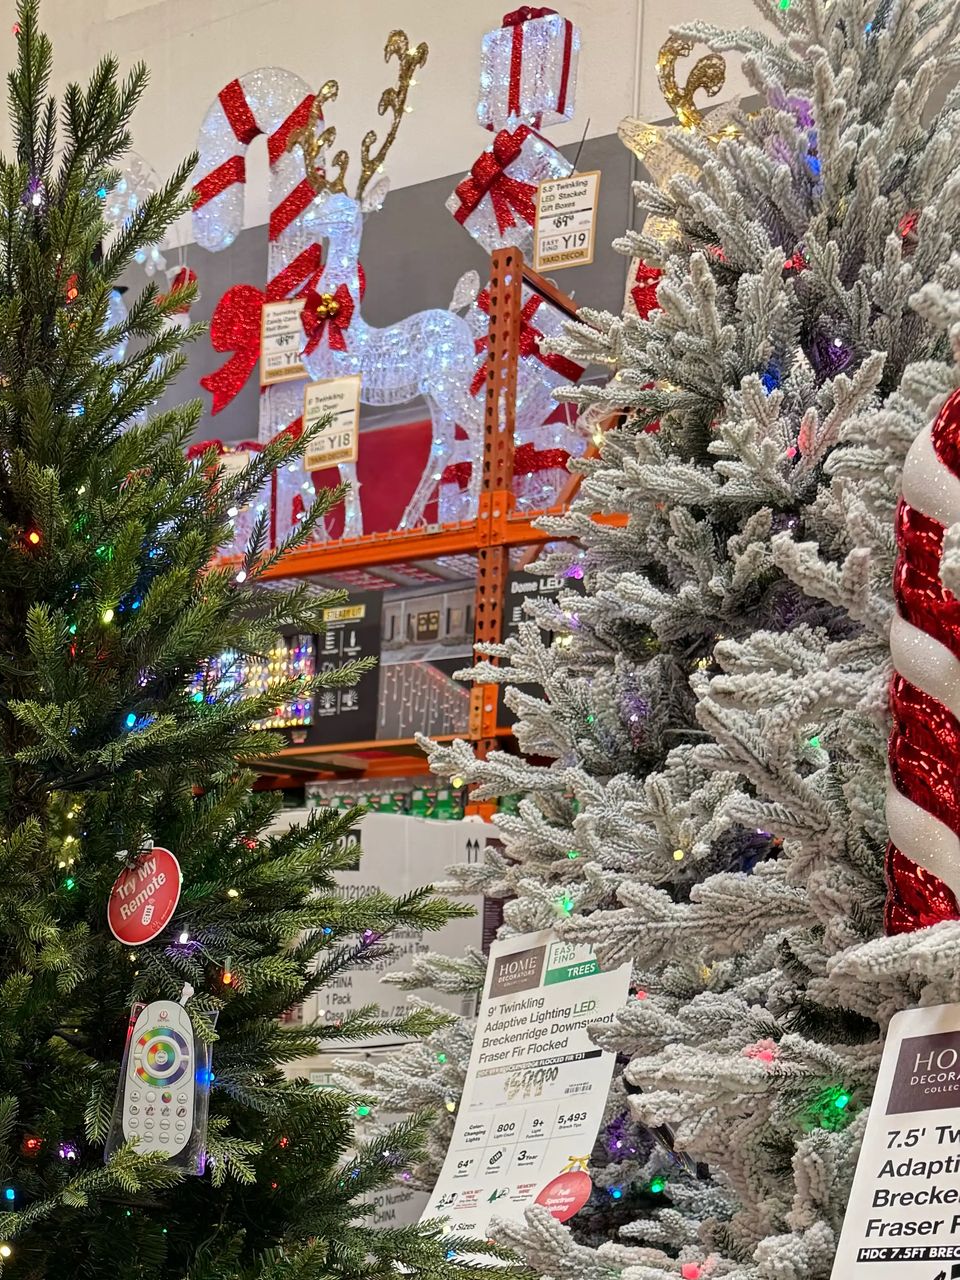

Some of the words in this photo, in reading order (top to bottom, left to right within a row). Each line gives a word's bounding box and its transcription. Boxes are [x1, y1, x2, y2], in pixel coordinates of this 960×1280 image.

[557, 180, 588, 190] Twinkling
[559, 189, 587, 200] Stacked
[562, 233, 585, 249] Y19
[561, 251, 584, 260] DECOR
[328, 433, 350, 448] Y18
[511, 581, 538, 594] Dome
[116, 878, 136, 900] Try
[138, 857, 156, 881] My
[120, 872, 166, 920] Remote
[554, 944, 576, 956] EASY
[553, 952, 576, 964] FIND
[499, 956, 537, 976] HOME
[567, 963, 596, 978] TREES
[498, 970, 536, 983] DECORATORS
[333, 993, 351, 1005] Pack
[488, 1006, 498, 1017] 9'
[499, 997, 545, 1016] Twinkling
[484, 1015, 528, 1033] Adaptive
[529, 1007, 572, 1024] Lighting
[573, 1000, 596, 1014] LED
[482, 1028, 548, 1048] Breckenridge
[478, 1049, 510, 1064] Fraser
[511, 1046, 526, 1058] Fir
[527, 1037, 569, 1055] Flocked
[532, 1119, 544, 1128] 9+
[557, 1112, 587, 1124] 5,493
[497, 1122, 515, 1132] 800
[887, 1128, 926, 1149] 7.5'
[518, 1150, 527, 1160] 3
[373, 1209, 396, 1224] CHINA
[456, 1223, 477, 1231] Sizes
[865, 1217, 945, 1238] Fraser
[860, 1249, 888, 1260] HDC
[890, 1248, 925, 1259] 7.5FT
